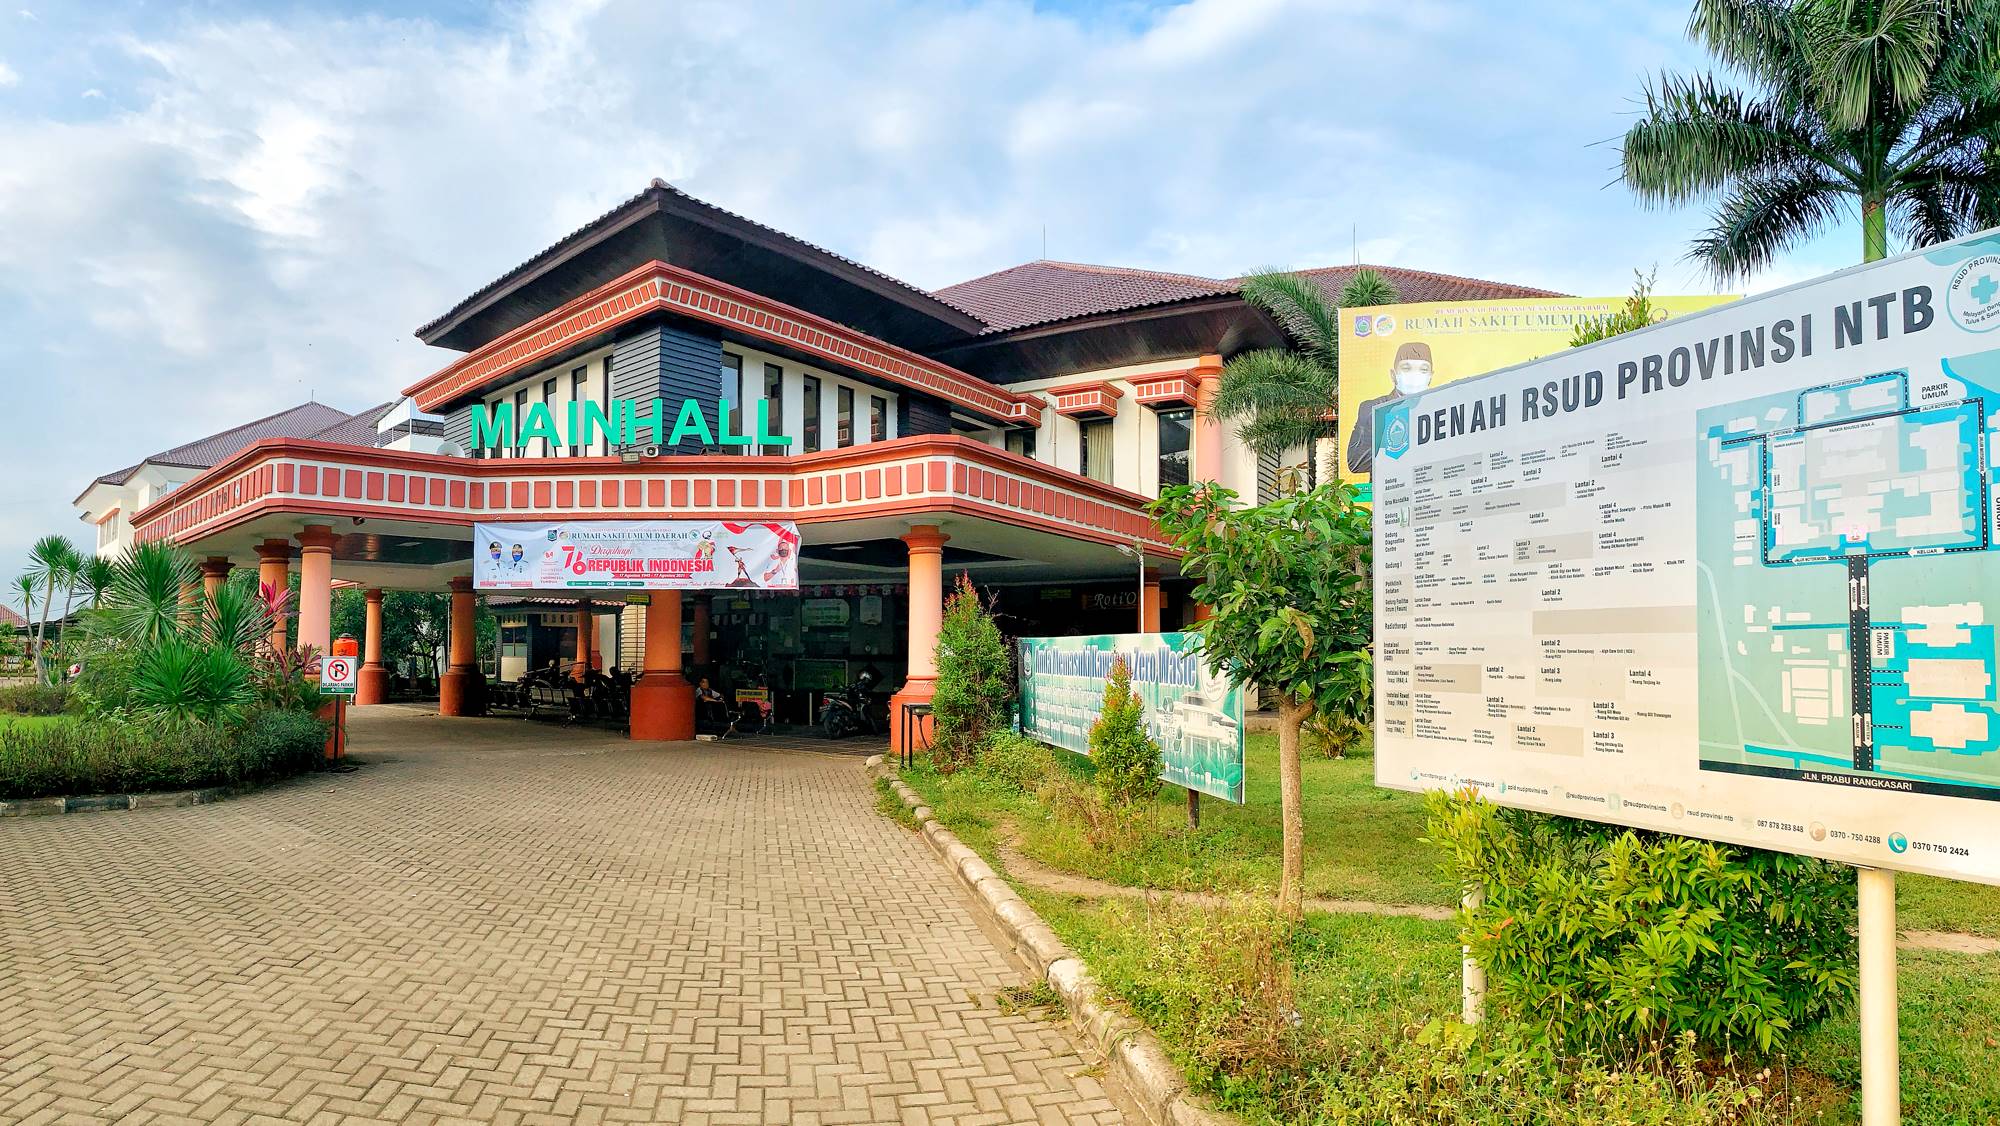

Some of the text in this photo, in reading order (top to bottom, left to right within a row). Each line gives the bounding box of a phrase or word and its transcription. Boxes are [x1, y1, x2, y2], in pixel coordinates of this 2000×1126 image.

[1952, 268, 1968, 290] RSUD
[1405, 317, 1463, 330] RUMAH
[1470, 315, 1519, 328] SAKIT
[1525, 314, 1573, 327] UMUM
[1417, 285, 1935, 445] DENAH RSUD PROVINSI NTB
[1922, 382, 1948, 393] PARKIR
[1922, 390, 1949, 400] UMUM
[472, 399, 792, 449] MAINHALL
[572, 532, 688, 540] RUMAH SAKIT UMUM DAERAH
[562, 545, 587, 575] 76
[588, 559, 714, 572] REPUBLIK INDONESIA
[1134, 648, 1156, 683] Zero
[1158, 644, 1196, 687] Waste
[1802, 772, 1912, 791] JLN. PRABU RANGKASARI
[1686, 809, 1699, 817] rsud
[1700, 812, 1722, 822] provinsi
[1781, 822, 1791, 831] 283
[1830, 830, 1846, 840] 0370
[1852, 833, 1863, 842] 750
[1864, 834, 1880, 844] 4288
[1912, 841, 1970, 856] 0370 750 2424
